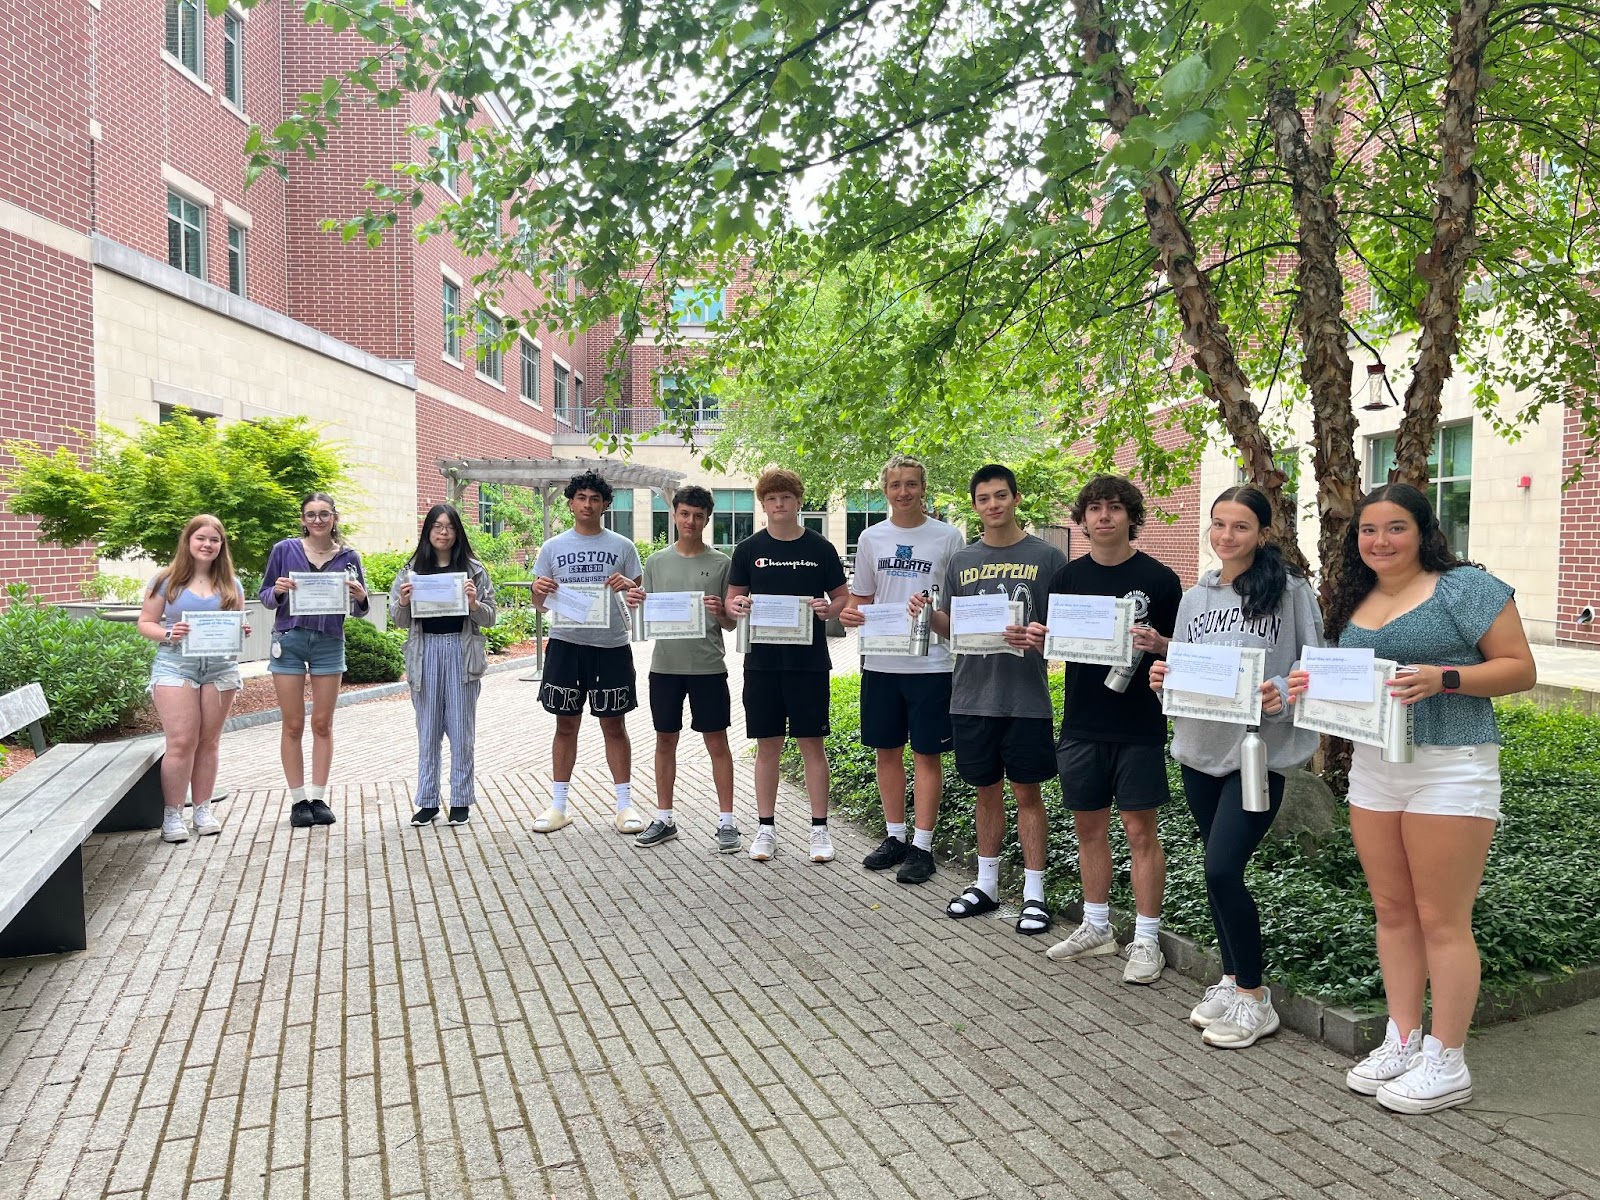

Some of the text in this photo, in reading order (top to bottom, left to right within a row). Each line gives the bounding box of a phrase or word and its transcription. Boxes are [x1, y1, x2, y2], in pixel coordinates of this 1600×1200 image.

[557, 551, 618, 568] BOSTON
[755, 558, 818, 569] Champion
[878, 559, 932, 572] WILDCATS
[569, 564, 603, 573] EST.1630
[886, 570, 918, 578] SOCCER
[960, 563, 1039, 586] LED ZEPPELIN
[560, 575, 611, 584] MASSACHUSET
[1187, 607, 1281, 645] ASSUMPTION
[544, 682, 630, 711] TRUE
